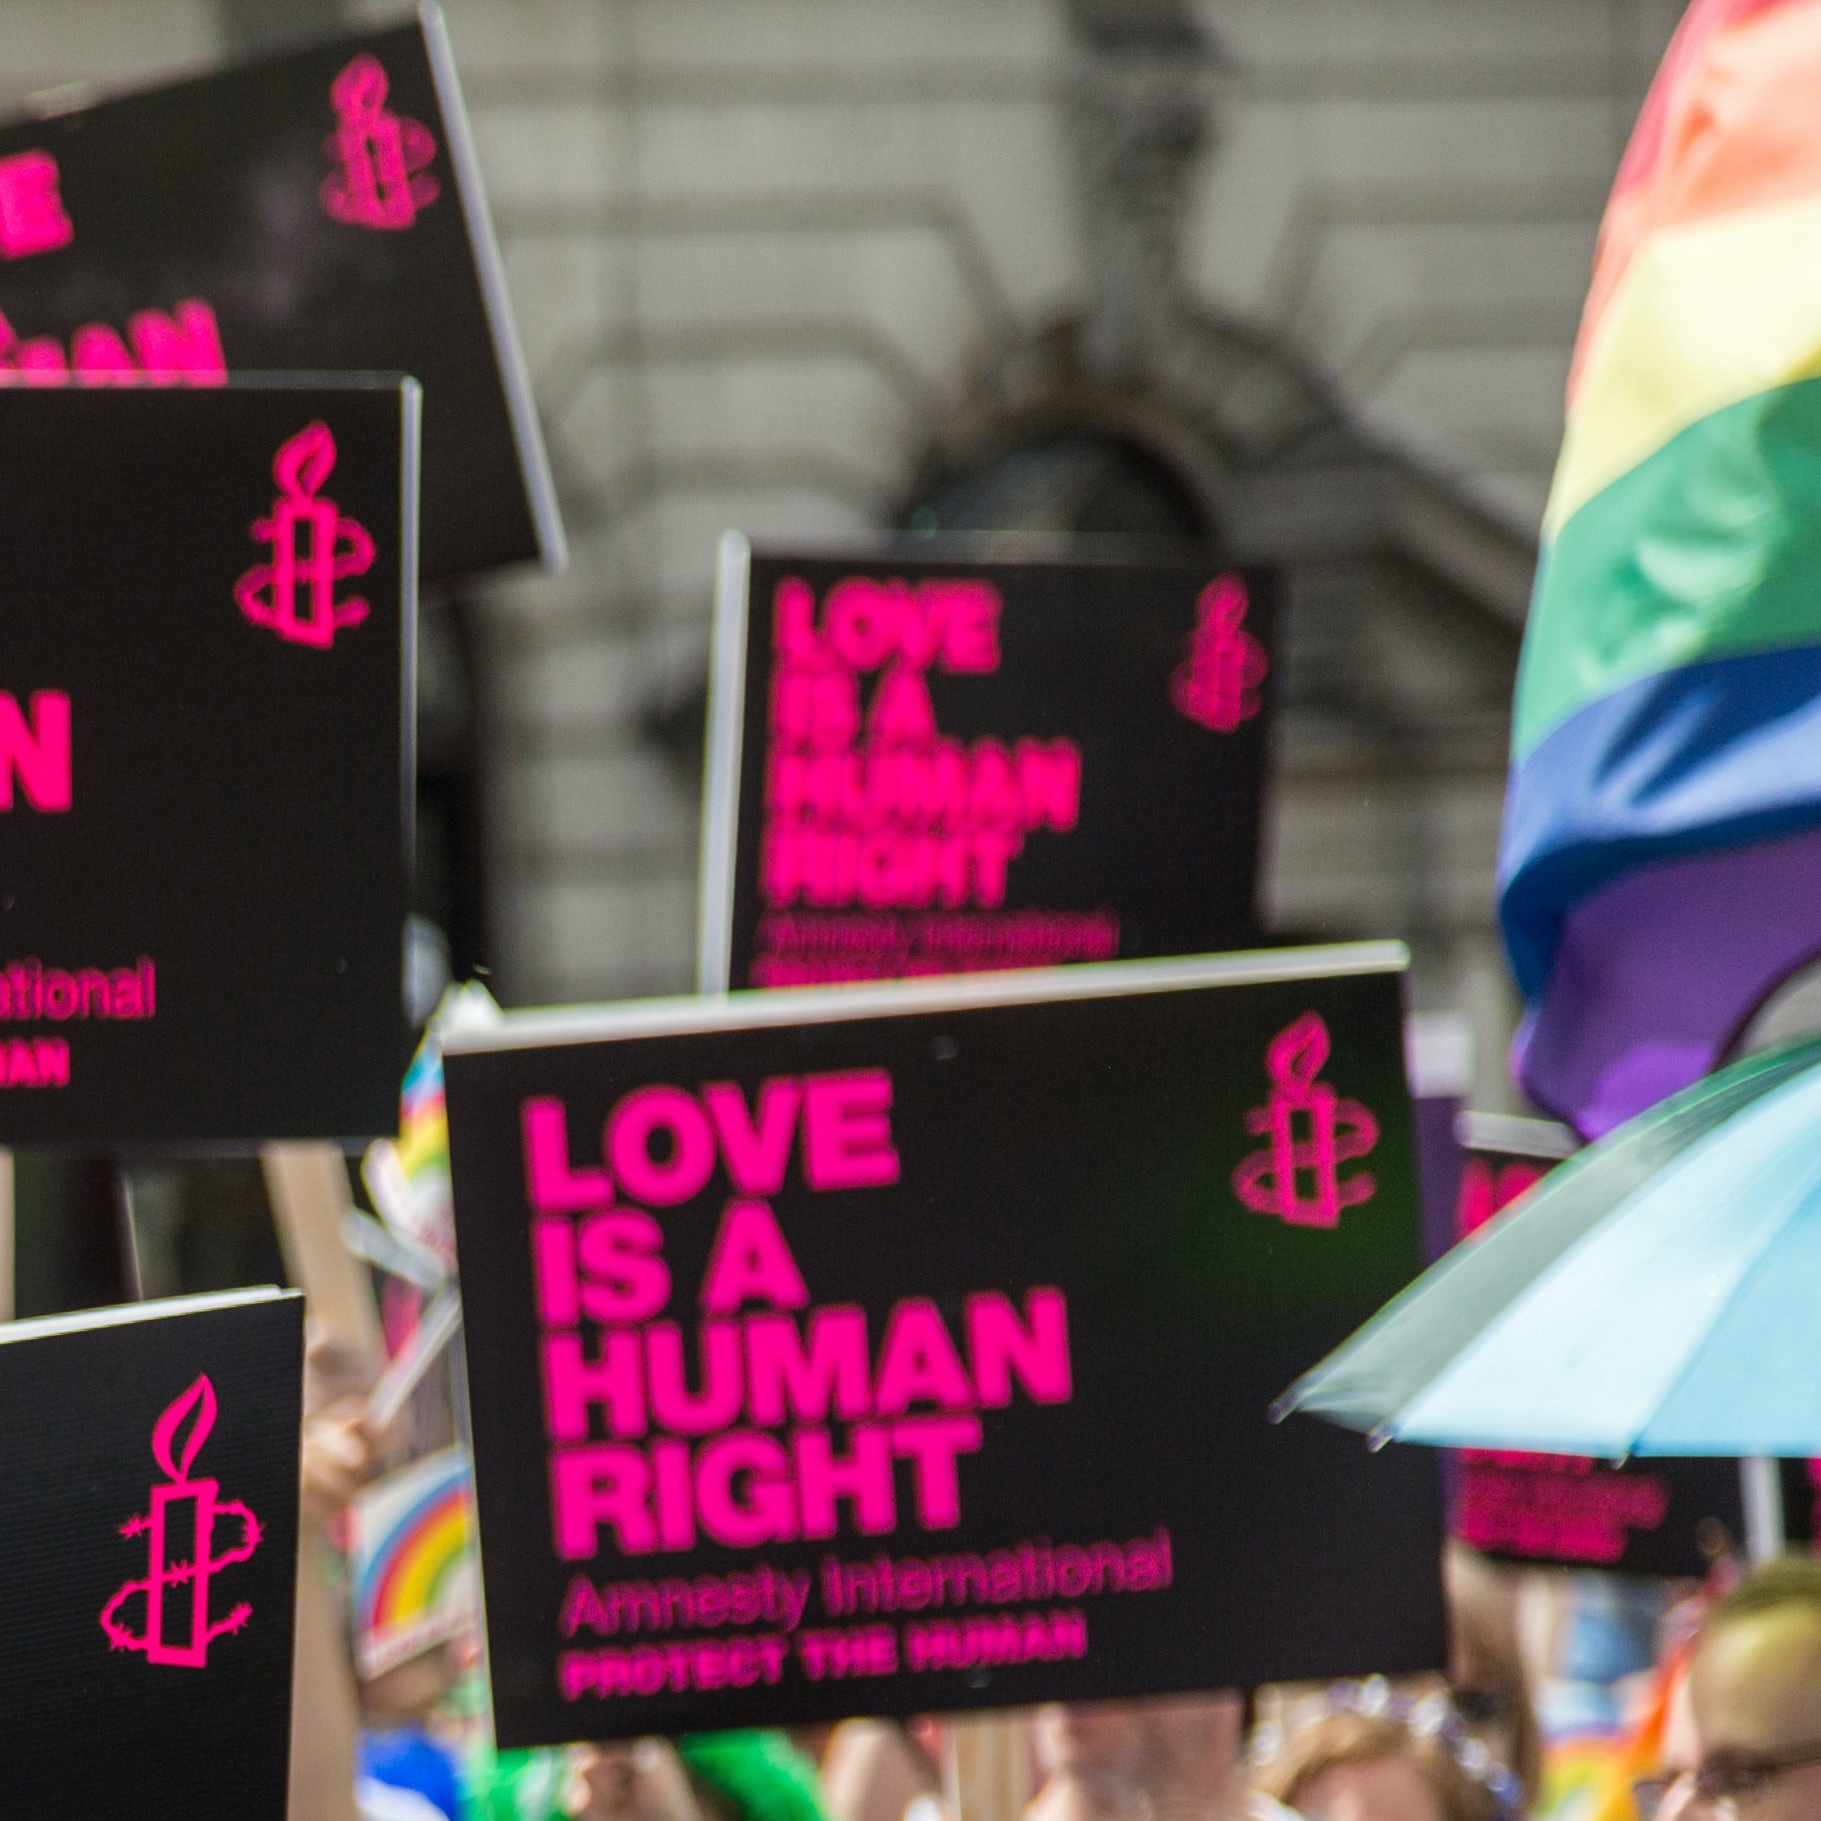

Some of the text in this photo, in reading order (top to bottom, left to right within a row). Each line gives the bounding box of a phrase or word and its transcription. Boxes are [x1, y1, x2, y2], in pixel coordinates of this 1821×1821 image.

[774, 576, 1002, 675] LOVE
[521, 1068, 900, 1212] LOVE
[533, 1207, 671, 1328] IS
[701, 1197, 810, 1315] A
[543, 1285, 1074, 1443] HUMAN
[551, 1414, 983, 1560] RIGHT
[563, 1562, 810, 1640] Amnesty
[824, 1527, 1173, 1618] International
[561, 1611, 1087, 1701] PROTECT THE HUMAN
